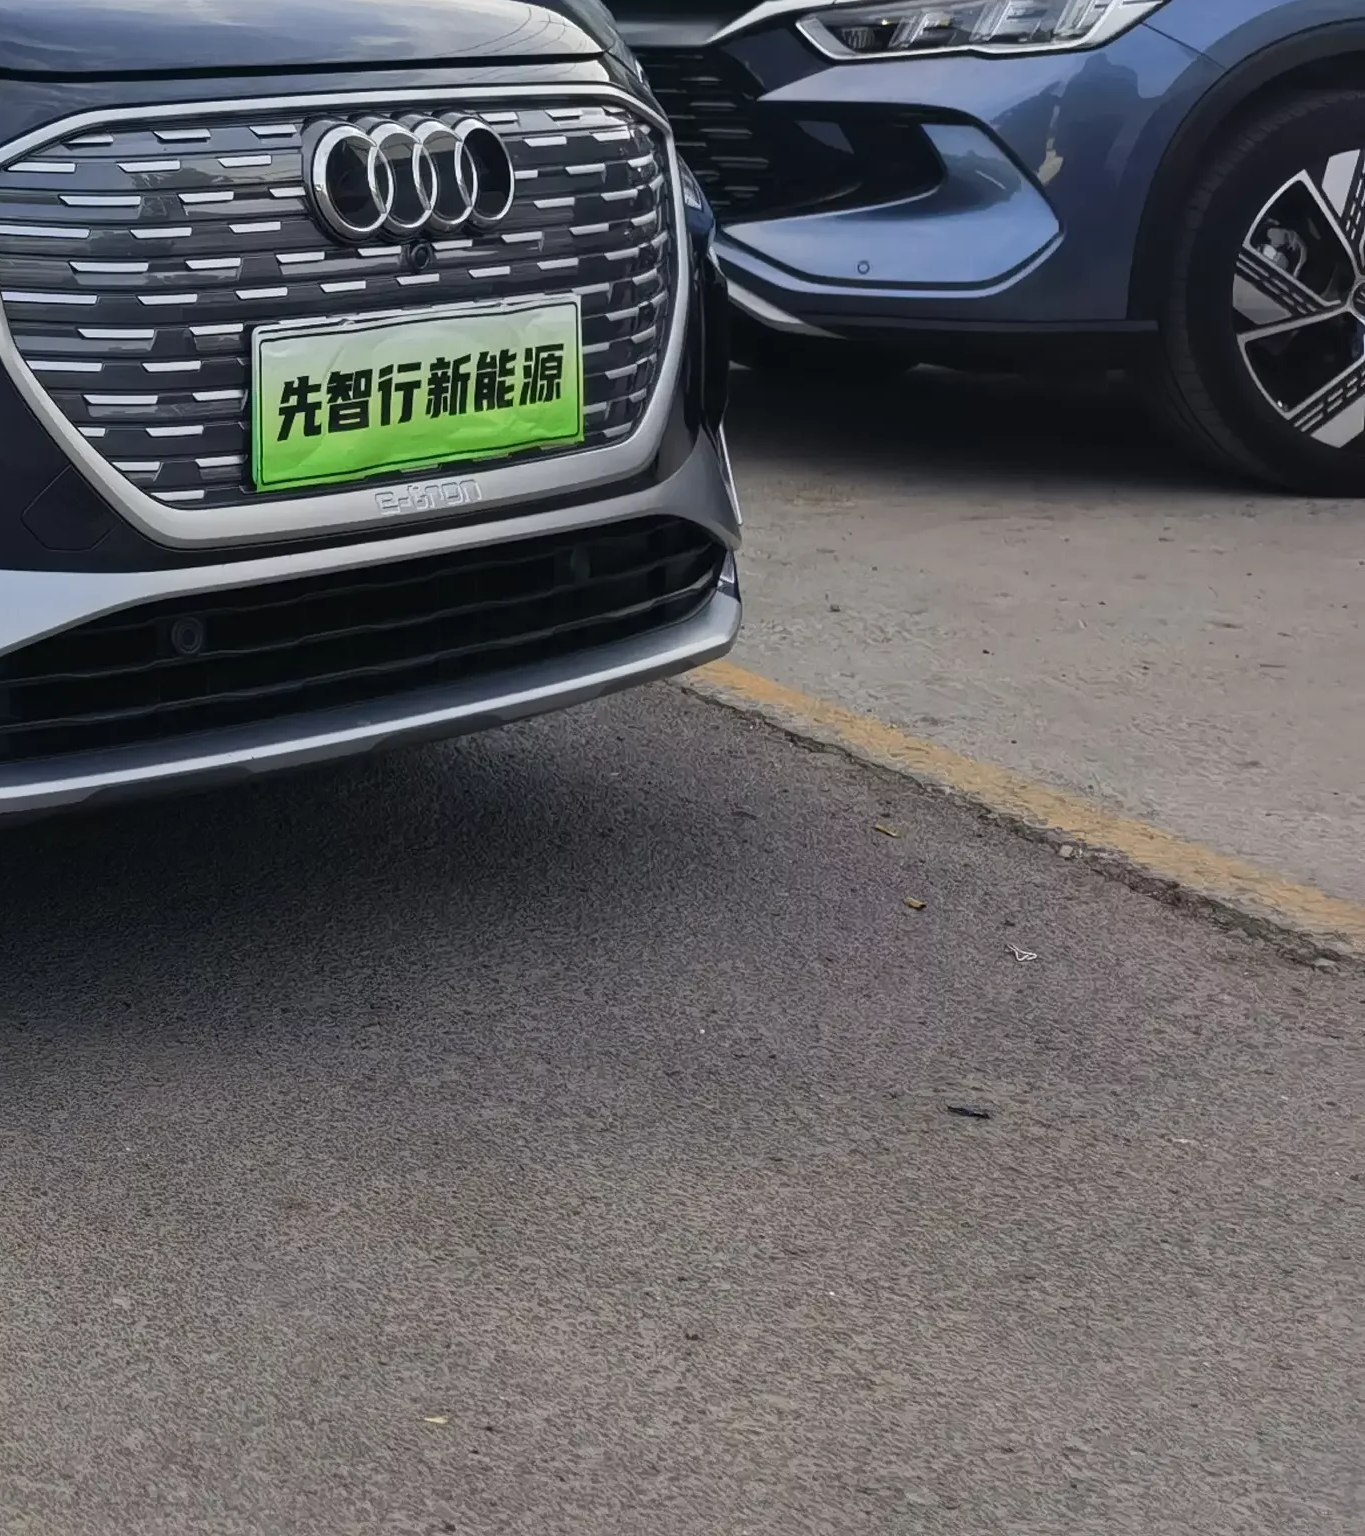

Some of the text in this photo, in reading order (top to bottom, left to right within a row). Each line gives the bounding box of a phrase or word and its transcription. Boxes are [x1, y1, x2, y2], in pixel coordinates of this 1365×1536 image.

[276, 342, 566, 443] 先智行新能源
[374, 478, 483, 516] e-tron
